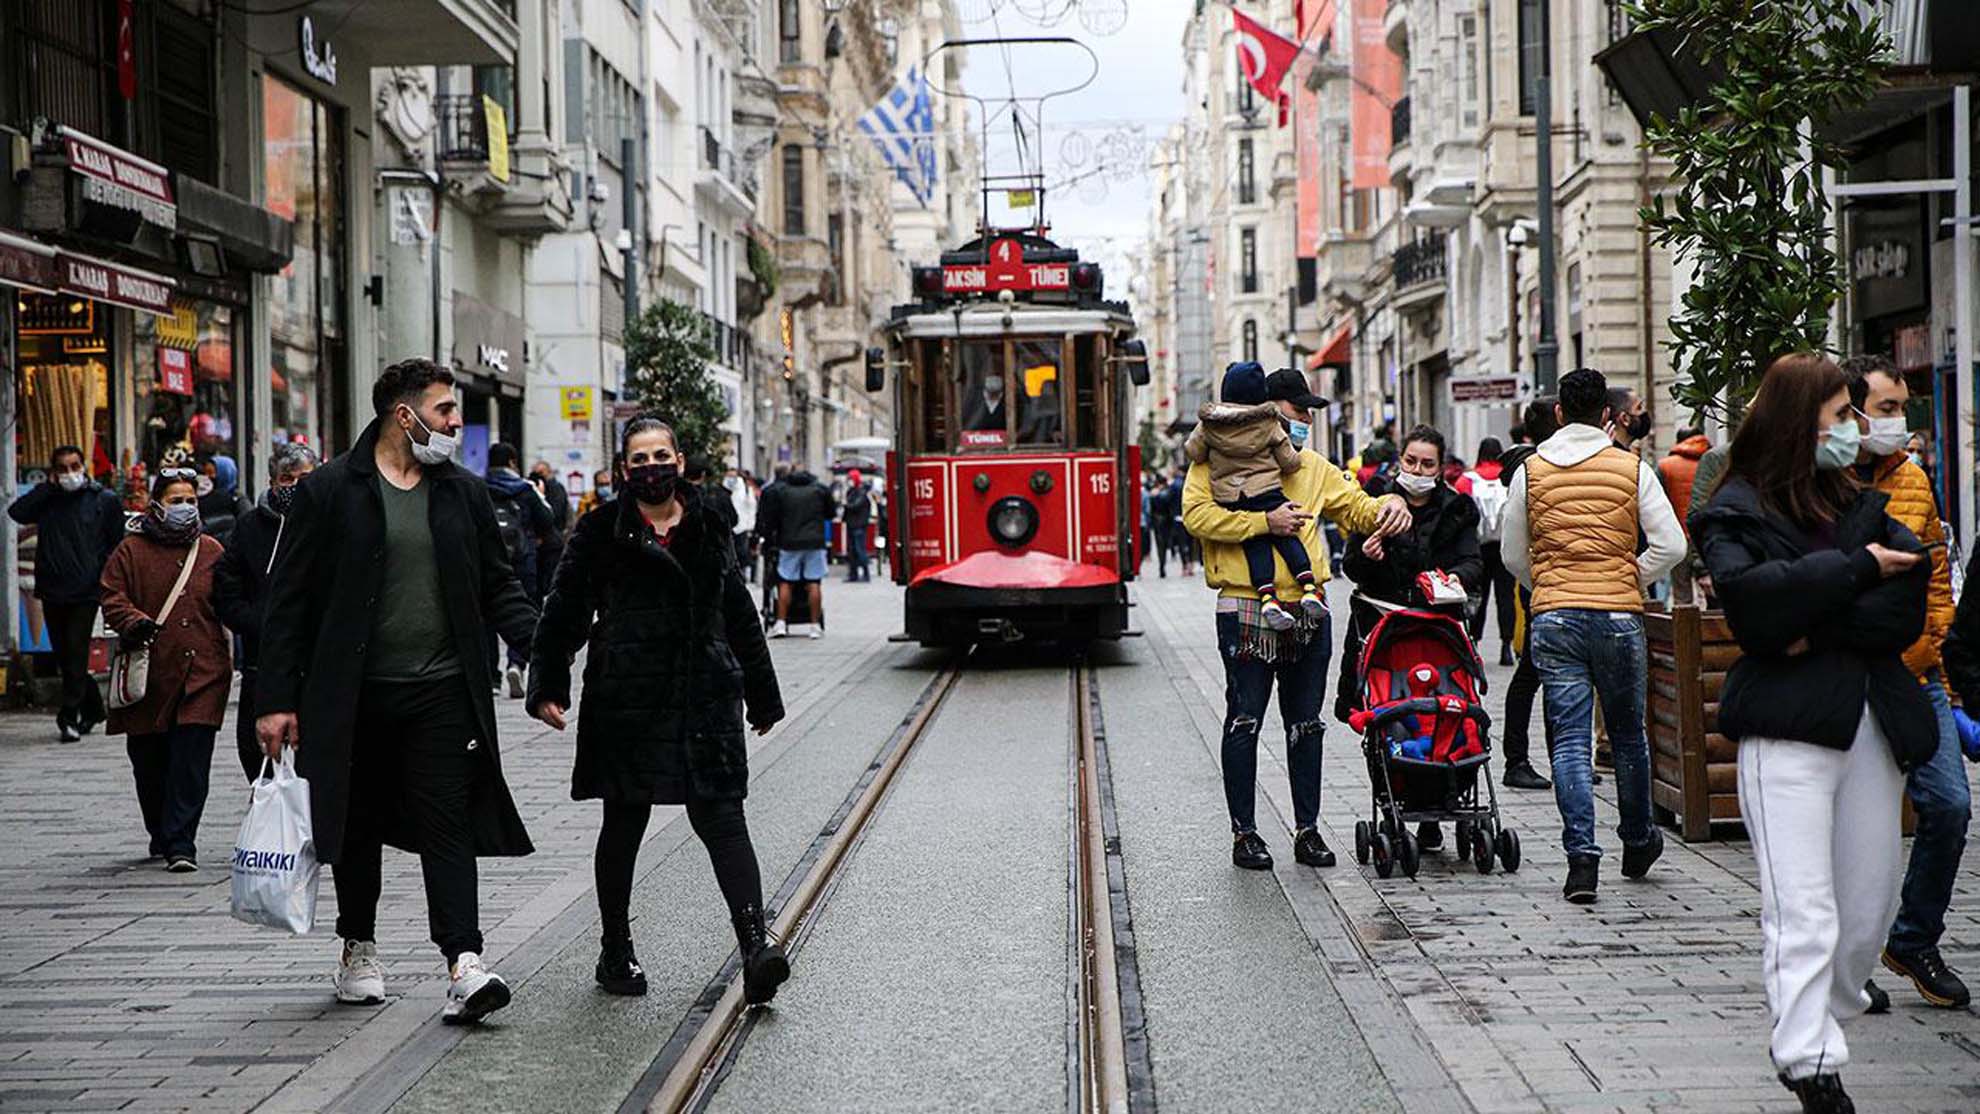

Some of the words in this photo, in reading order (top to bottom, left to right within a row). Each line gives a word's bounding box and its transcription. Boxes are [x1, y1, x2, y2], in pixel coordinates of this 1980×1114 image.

[998, 240, 1010, 263] 4
[967, 432, 1004, 445] TÜNEL
[914, 478, 934, 500] 115
[1090, 472, 1110, 495] 115
